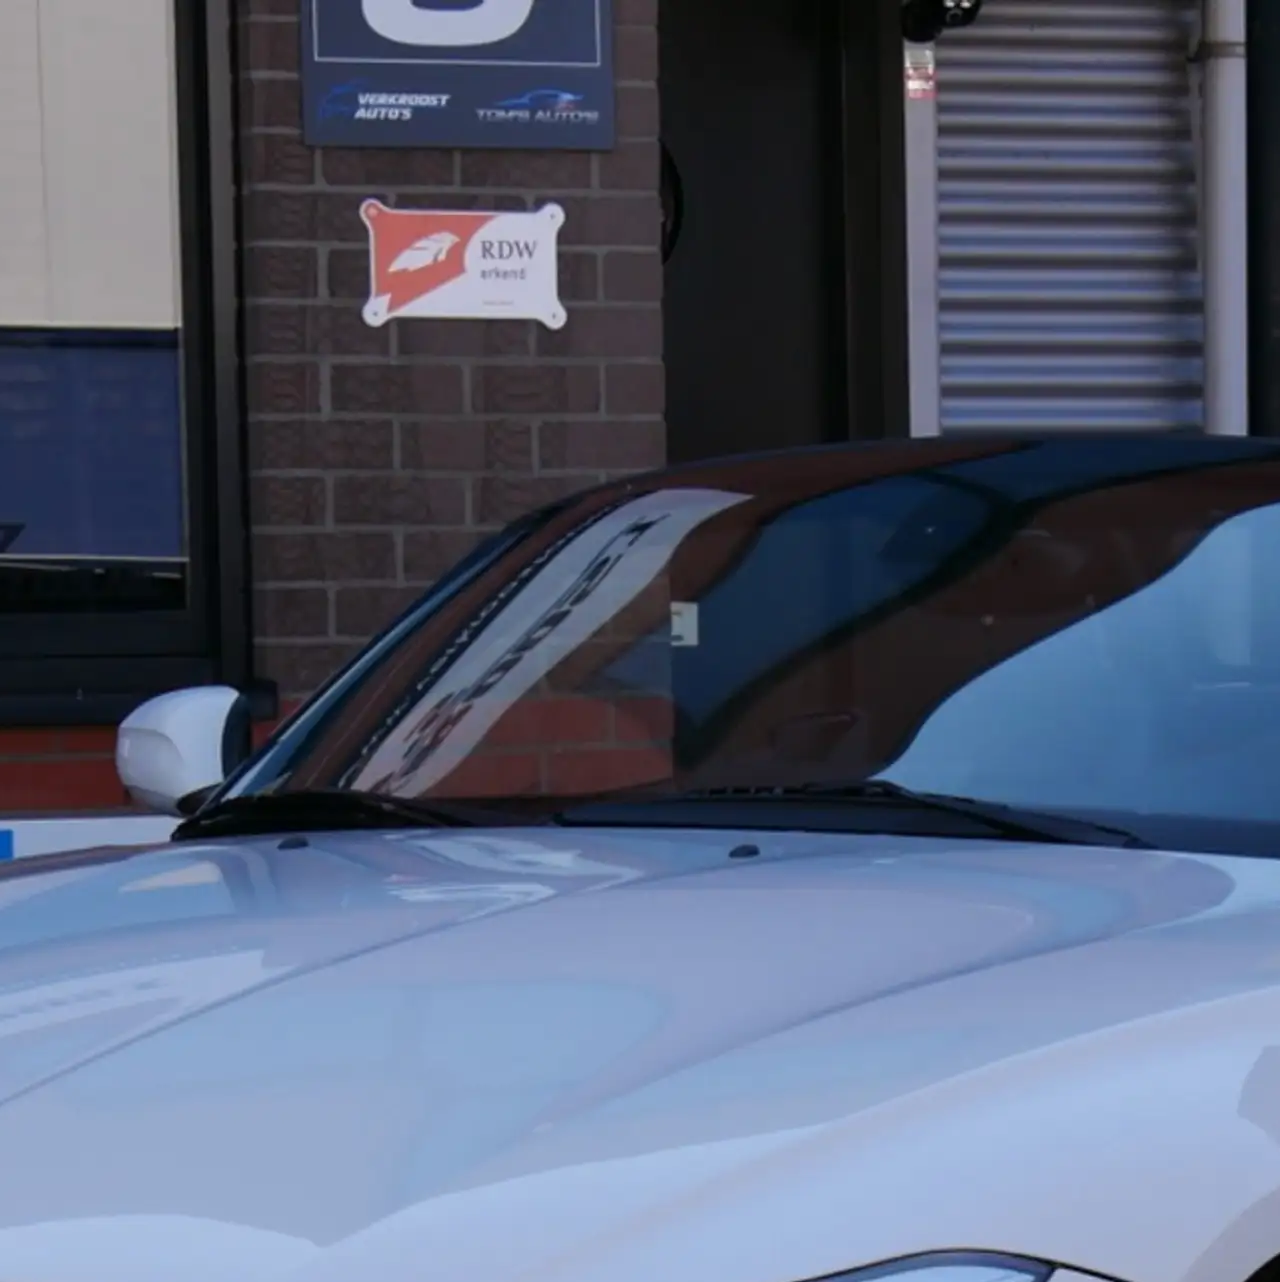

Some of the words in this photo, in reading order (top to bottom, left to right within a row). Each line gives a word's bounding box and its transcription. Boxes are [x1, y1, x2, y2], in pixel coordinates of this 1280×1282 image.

[357, 92, 451, 107] VERKROOST
[354, 106, 412, 122] AUTO'S
[481, 239, 538, 260] RDW
